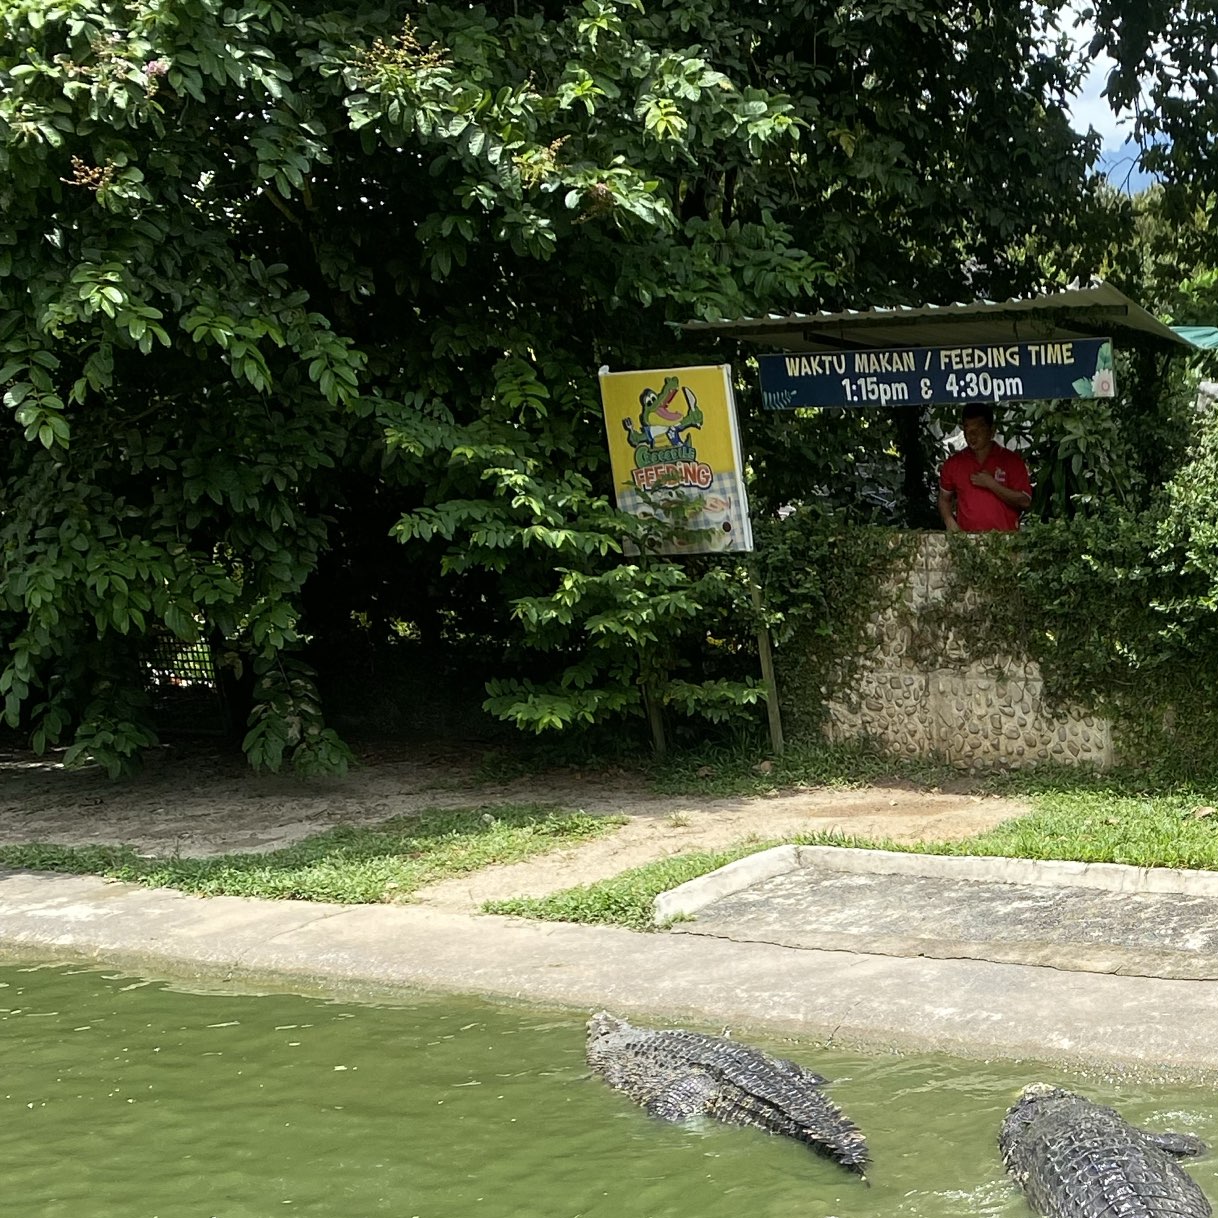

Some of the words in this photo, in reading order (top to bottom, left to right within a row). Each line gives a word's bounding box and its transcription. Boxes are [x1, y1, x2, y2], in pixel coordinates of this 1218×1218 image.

[785, 355, 846, 377] WAKTU
[855, 352, 915, 373] MAKAN
[924, 351, 931, 371] /
[940, 345, 1019, 370] FEEDING
[1028, 343, 1074, 365] TIME
[842, 377, 908, 404] 1:15pm
[921, 379, 933, 399] &
[946, 372, 1023, 402] 4:30pm
